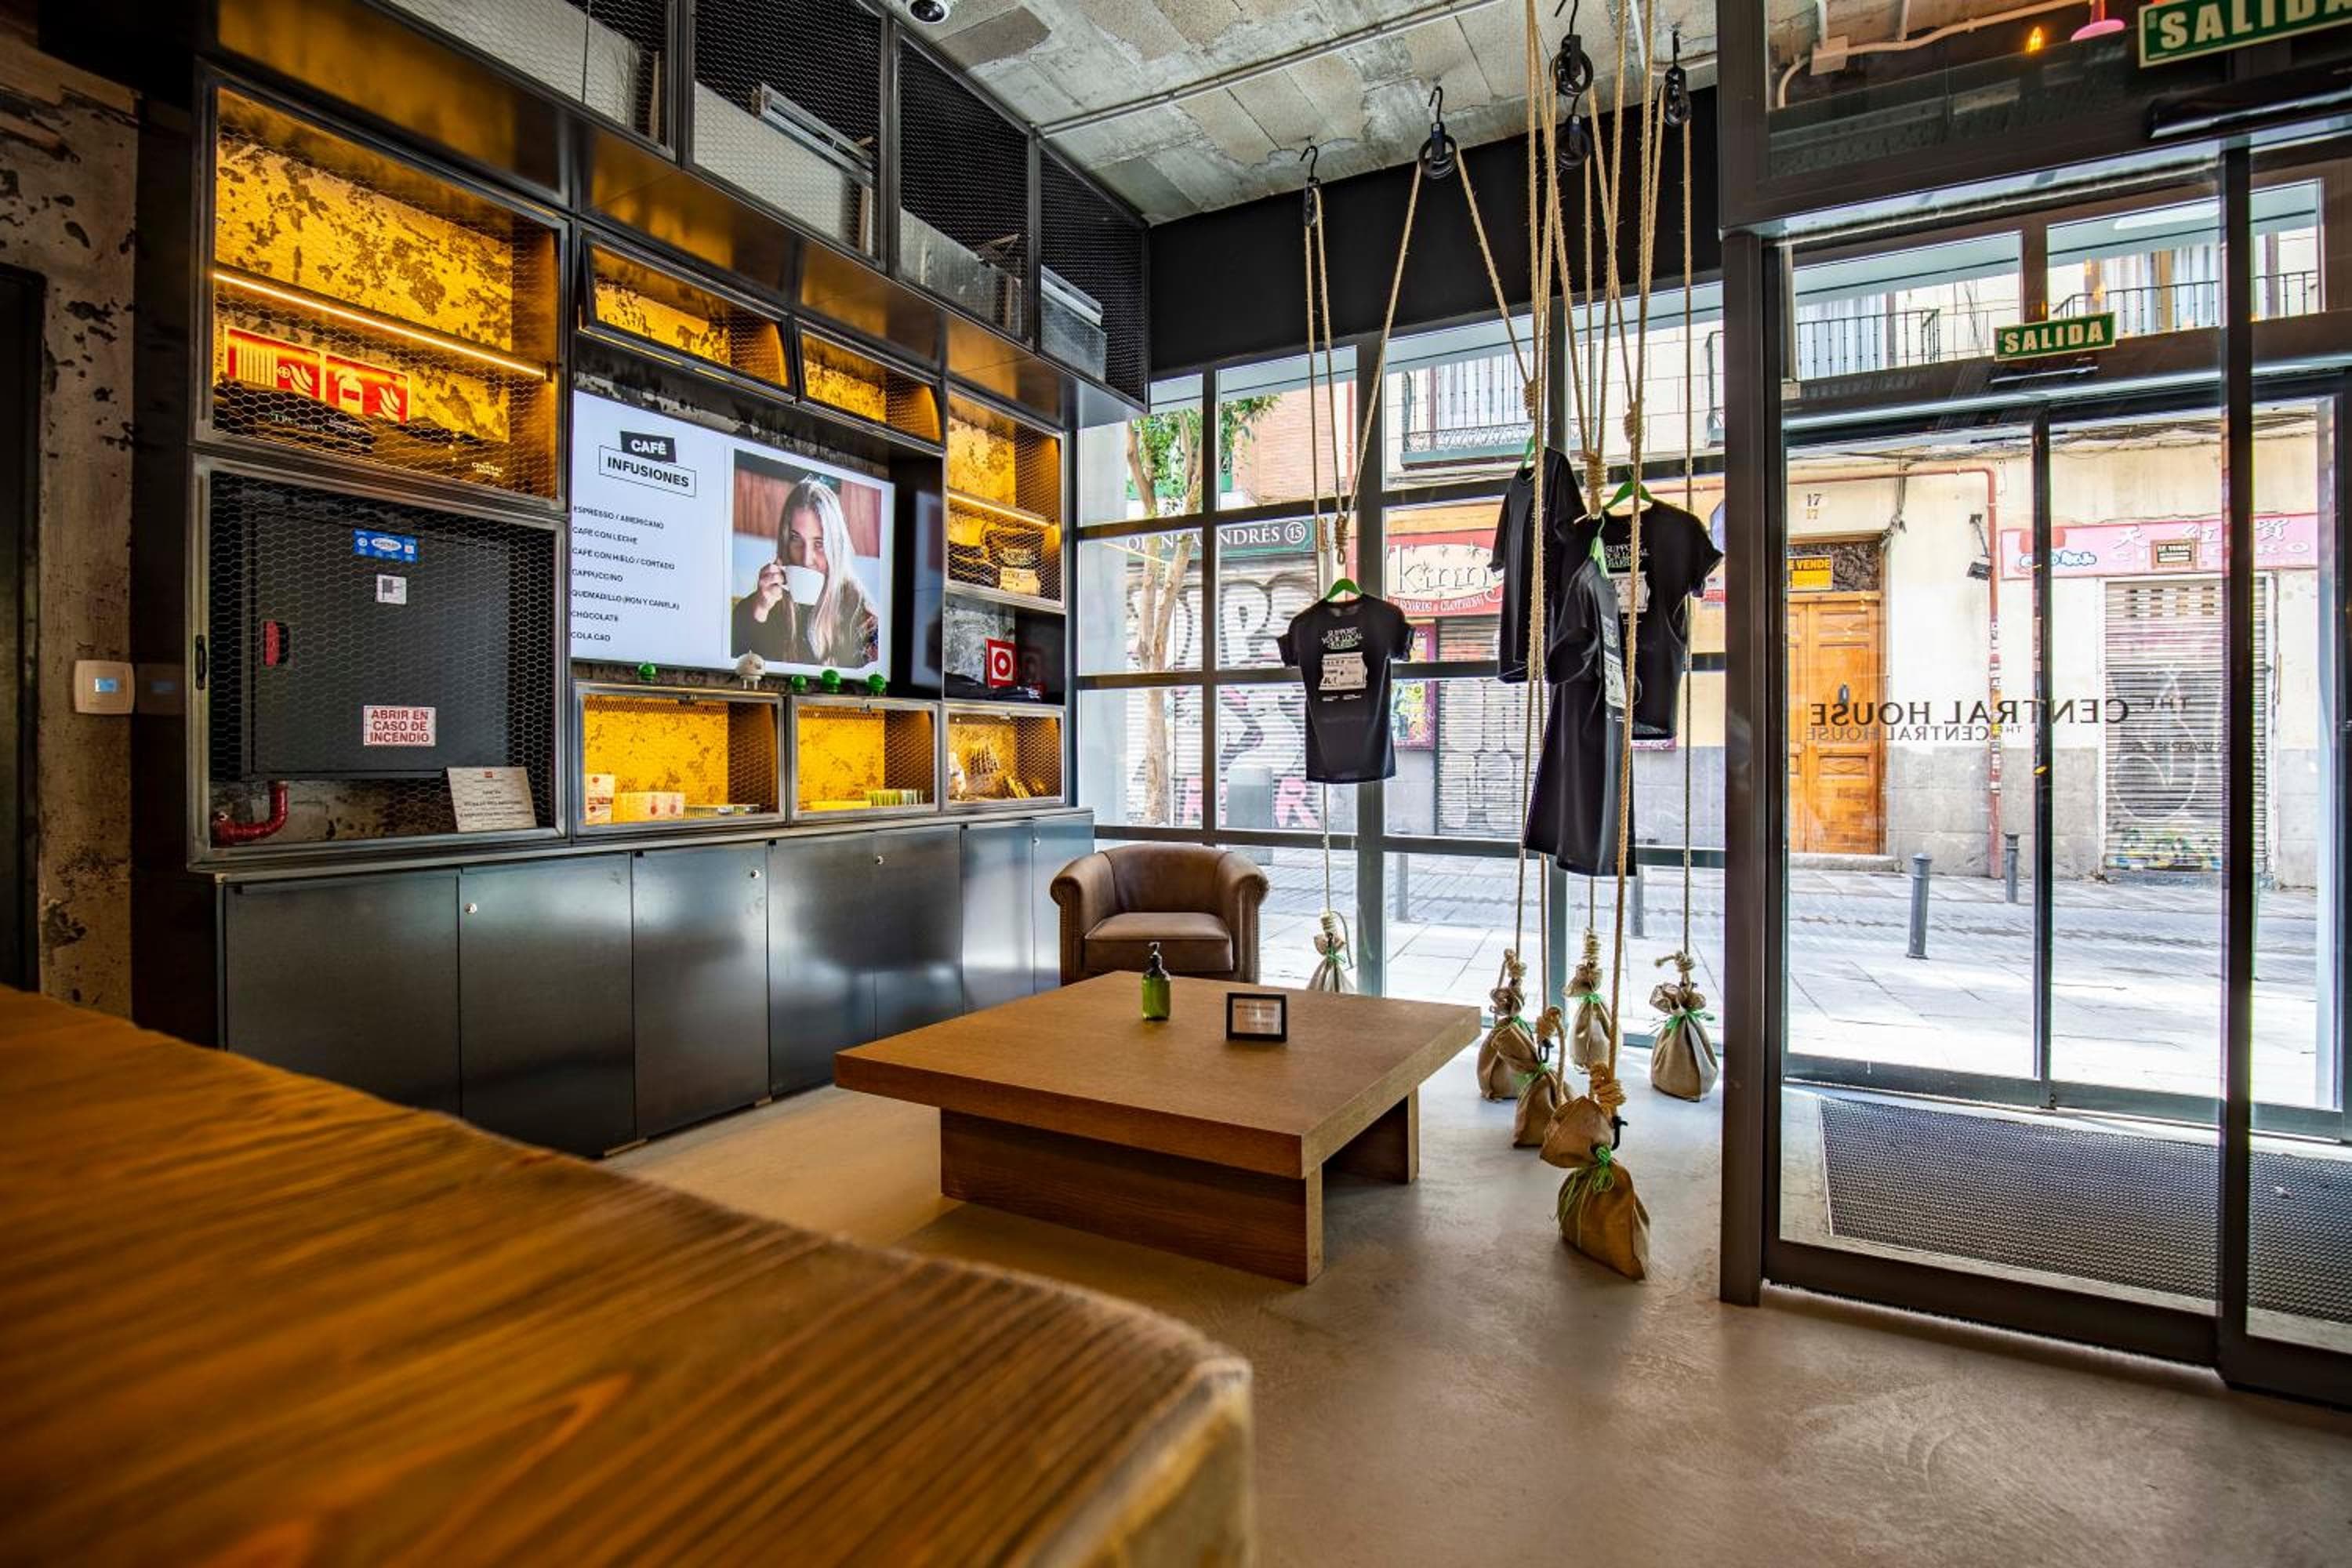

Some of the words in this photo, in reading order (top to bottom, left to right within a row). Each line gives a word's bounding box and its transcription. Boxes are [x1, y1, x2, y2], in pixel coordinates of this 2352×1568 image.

[2005, 321, 2104, 354] SALIDA
[630, 439, 667, 456] CAFÉ
[608, 456, 689, 488] INFUSIONES
[1807, 493, 1822, 506] 17
[574, 506, 615, 520] ESPRESSO
[594, 530, 612, 539] CON
[613, 533, 638, 544] LECHE
[1218, 524, 1280, 546] NDRÉS
[1288, 525, 1303, 539] 15
[593, 551, 612, 561] CON
[1796, 558, 1831, 570] VENDE
[572, 568, 623, 582] CAPPUCCINO
[571, 611, 619, 622] CHOCOLATE
[372, 710, 408, 720] ABRIR
[413, 710, 428, 720] EN
[373, 721, 407, 731] CASO
[412, 721, 427, 731] DE
[369, 731, 429, 742] INCENDIO
